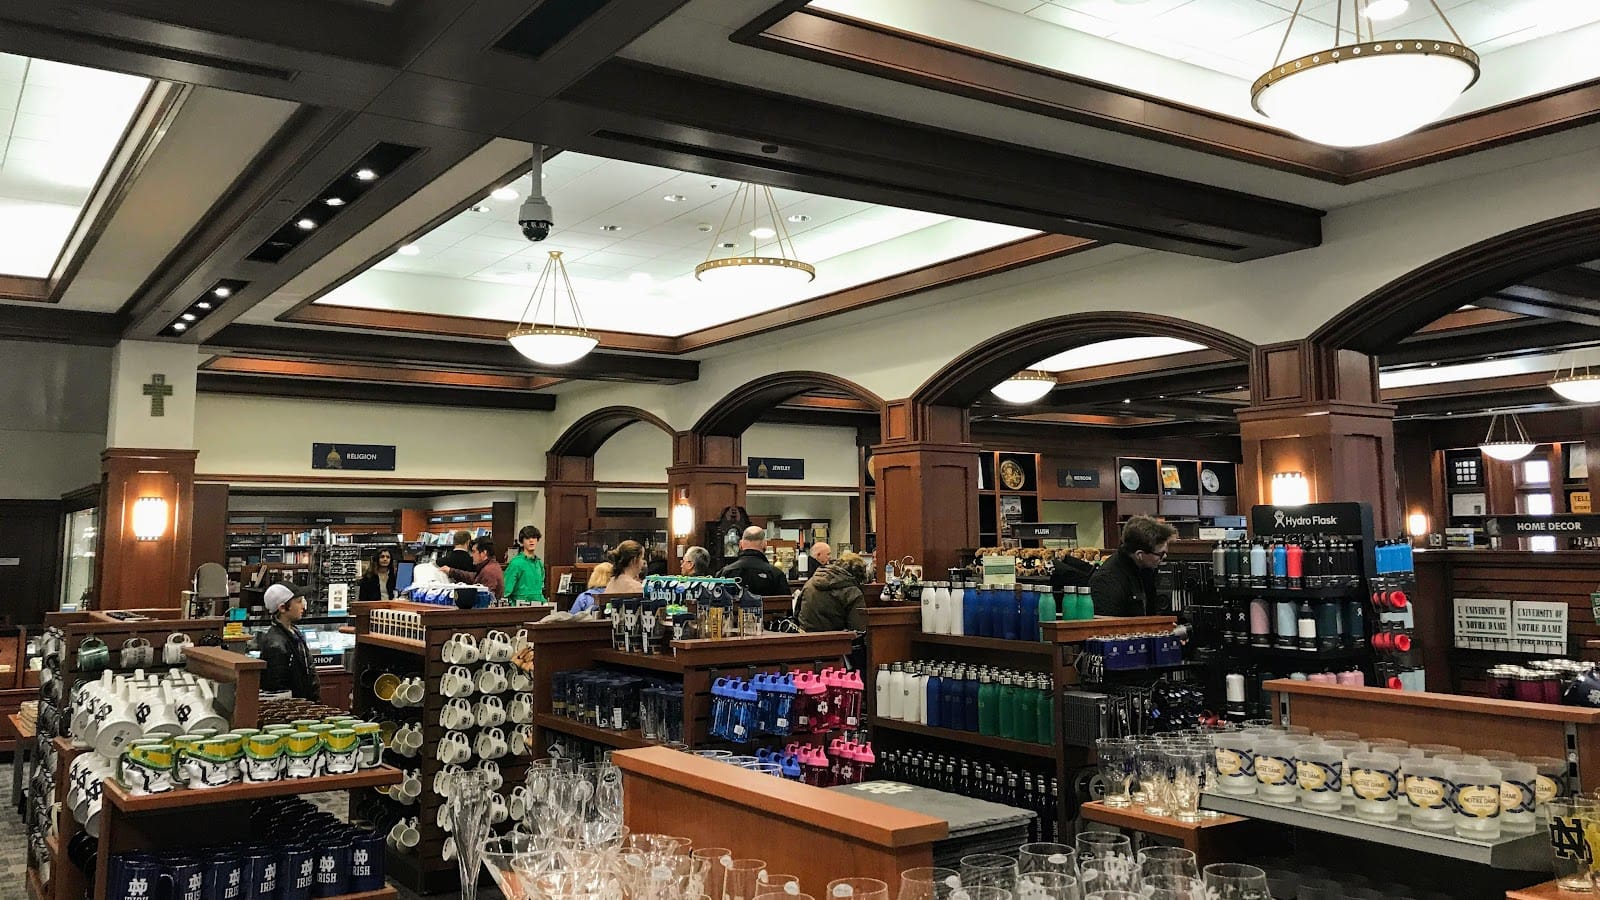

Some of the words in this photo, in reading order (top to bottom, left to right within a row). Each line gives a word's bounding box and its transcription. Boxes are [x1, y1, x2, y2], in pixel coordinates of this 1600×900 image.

[1285, 516, 1311, 528] Hydro
[1312, 515, 1338, 525] Flask
[1517, 522, 1546, 531] HOME
[1548, 522, 1582, 531] DECOR
[1465, 606, 1497, 615] UNIVERSITY
[1517, 608, 1553, 618] UNIVERSITY
[1466, 620, 1486, 630] NOTRE
[1488, 621, 1507, 631] DAME
[1517, 623, 1540, 633] NOTRE
[1541, 624, 1562, 634] DAME
[313, 656, 334, 664] SHOP
[1464, 796, 1482, 804] NOTRE
[1502, 792, 1517, 800] DAME
[352, 865, 371, 876] RISH
[260, 880, 275, 893] IRIS
[296, 876, 313, 889] IRIS
[224, 885, 239, 899] IRIS
